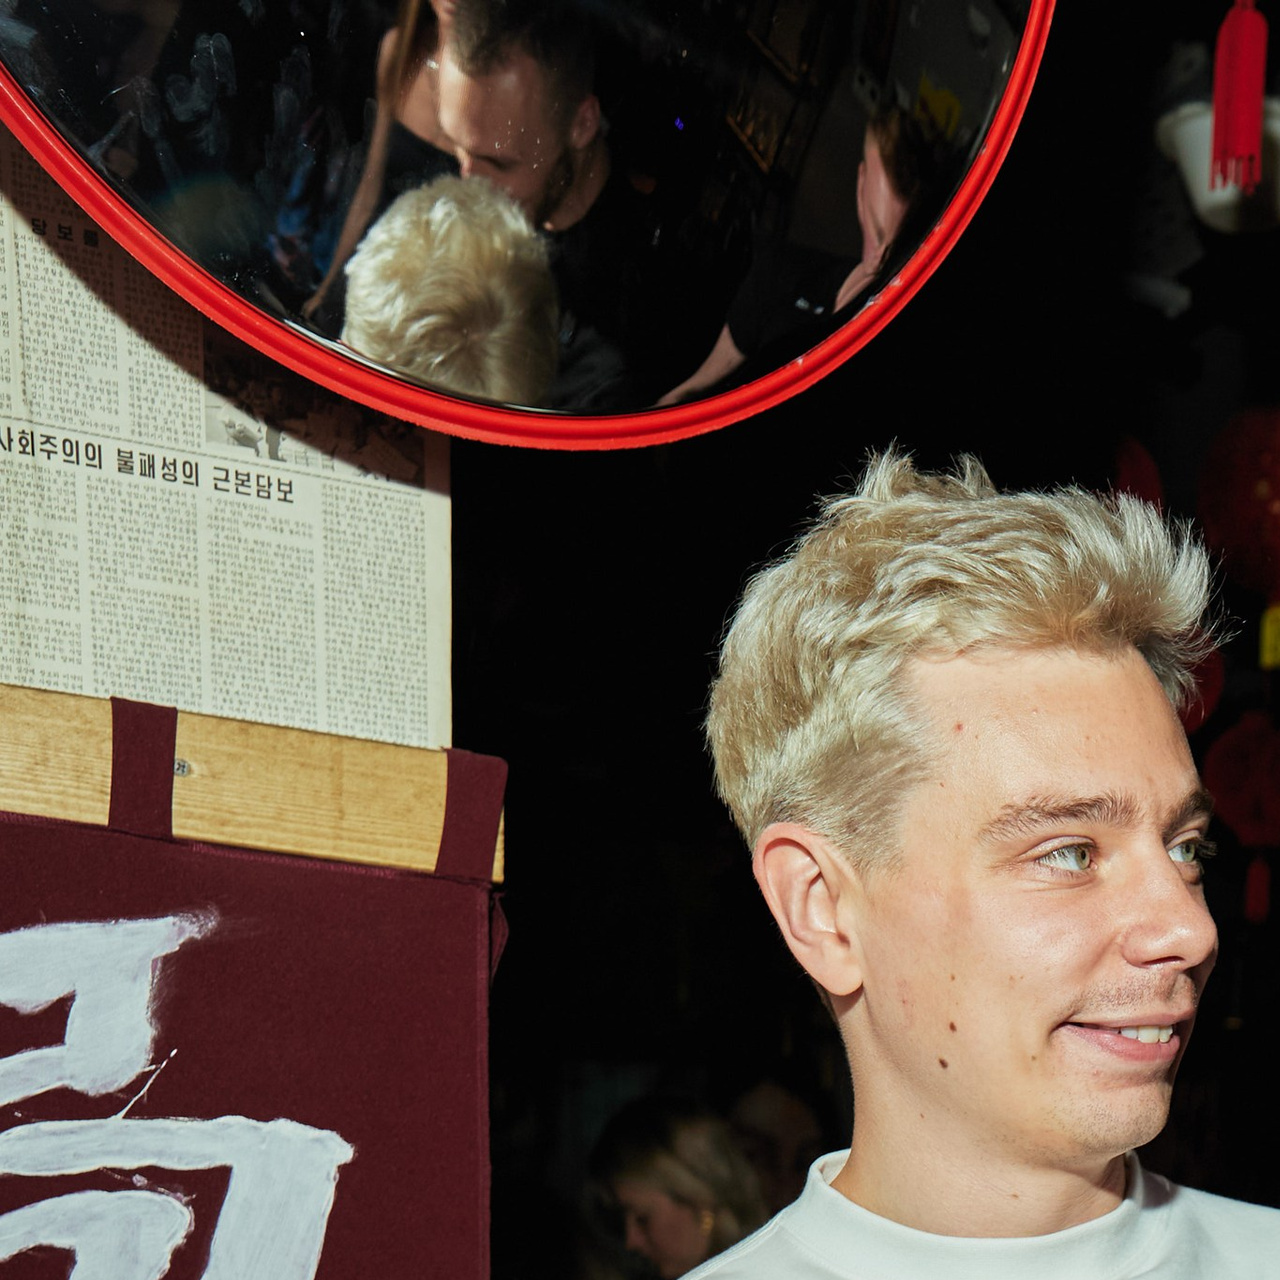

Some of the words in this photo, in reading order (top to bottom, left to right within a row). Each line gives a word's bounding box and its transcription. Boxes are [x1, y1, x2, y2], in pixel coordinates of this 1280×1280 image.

[0, 426, 103, 470] 사회주의의
[117, 447, 200, 488] 불패성의
[213, 464, 295, 504] 근본담보
